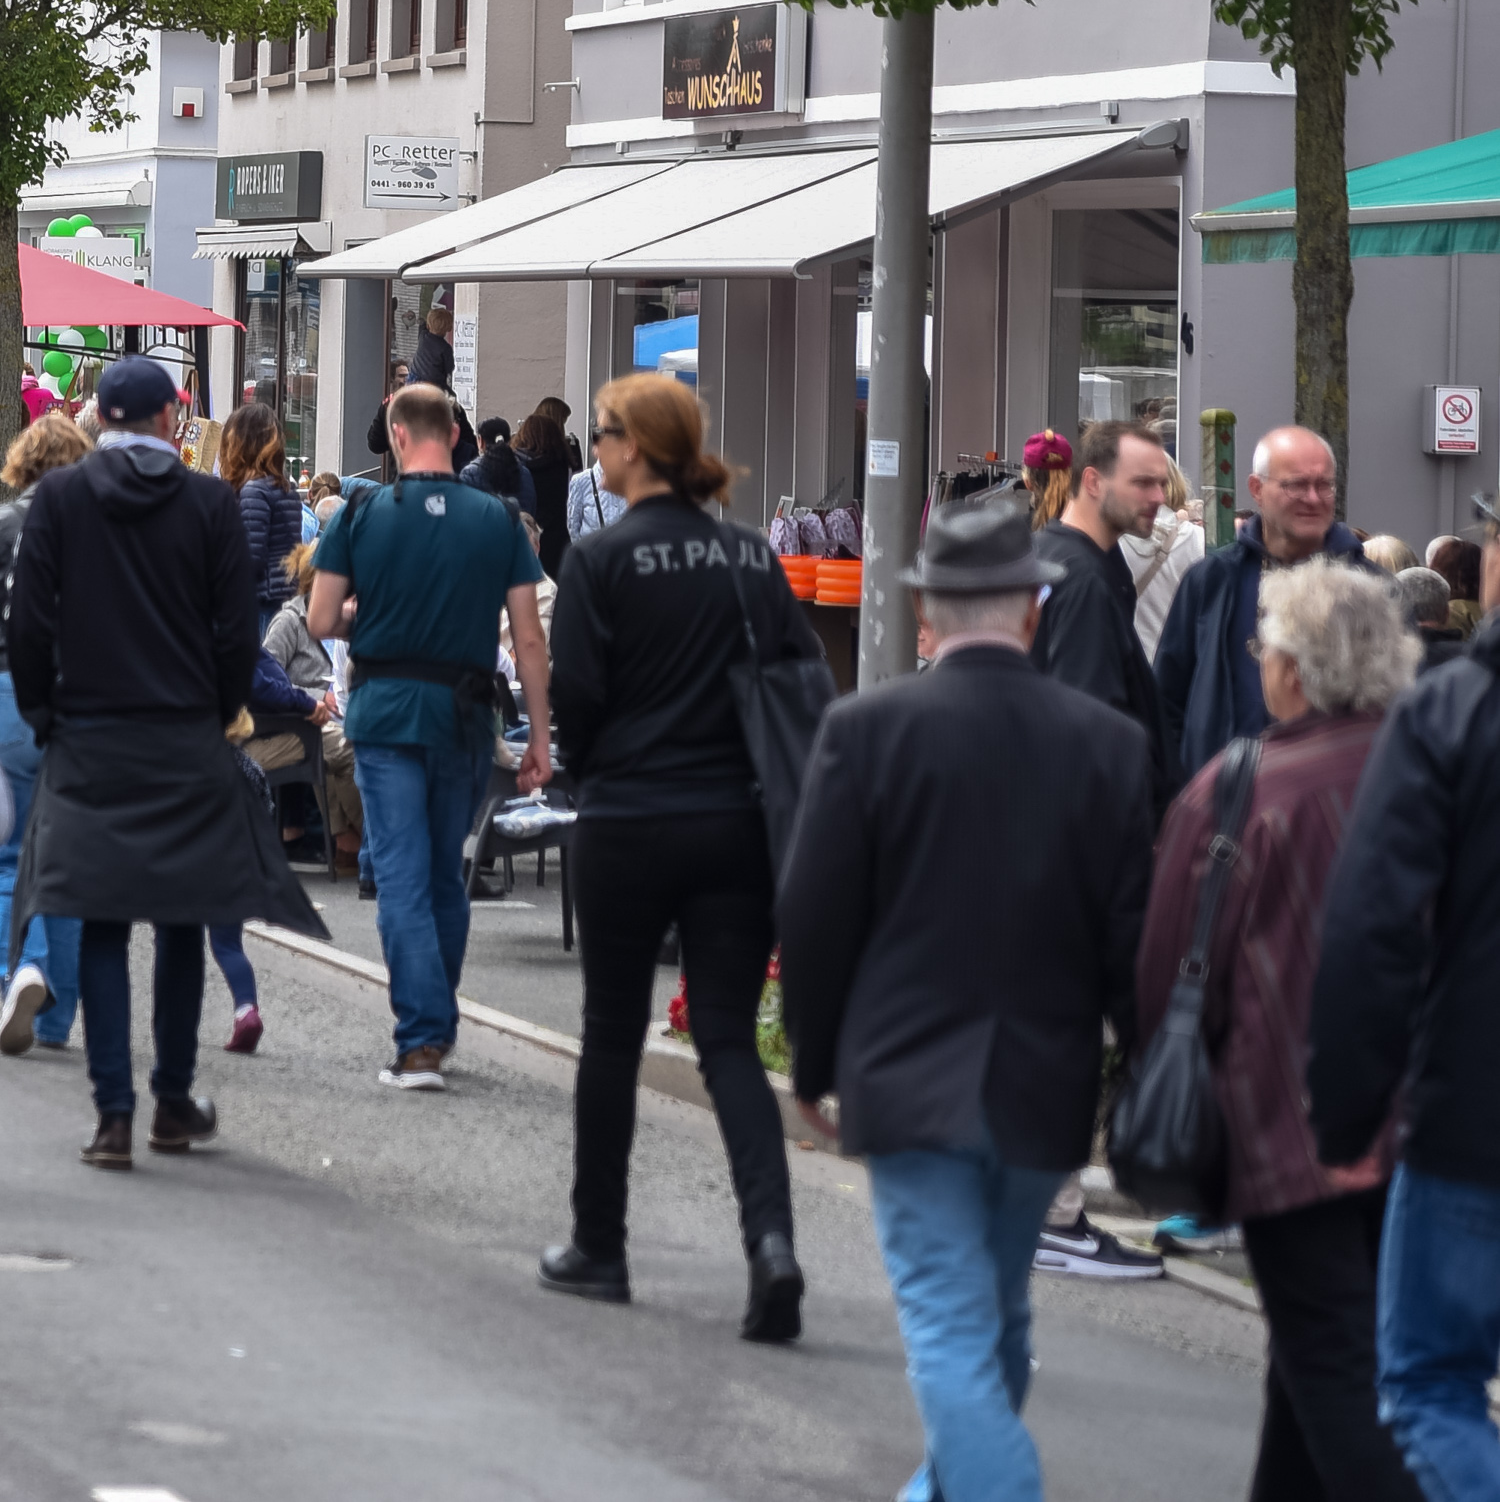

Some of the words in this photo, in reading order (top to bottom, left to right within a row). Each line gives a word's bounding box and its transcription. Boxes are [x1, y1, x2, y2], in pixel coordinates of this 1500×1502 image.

[687, 70, 763, 111] WUNSCHHAUS
[372, 144, 391, 158] PC
[402, 145, 457, 161] Retter
[371, 179, 390, 188] 0441
[413, 181, 424, 189] 39
[425, 181, 435, 189] 45
[87, 255, 133, 268] KLANG
[633, 543, 681, 575] ST.
